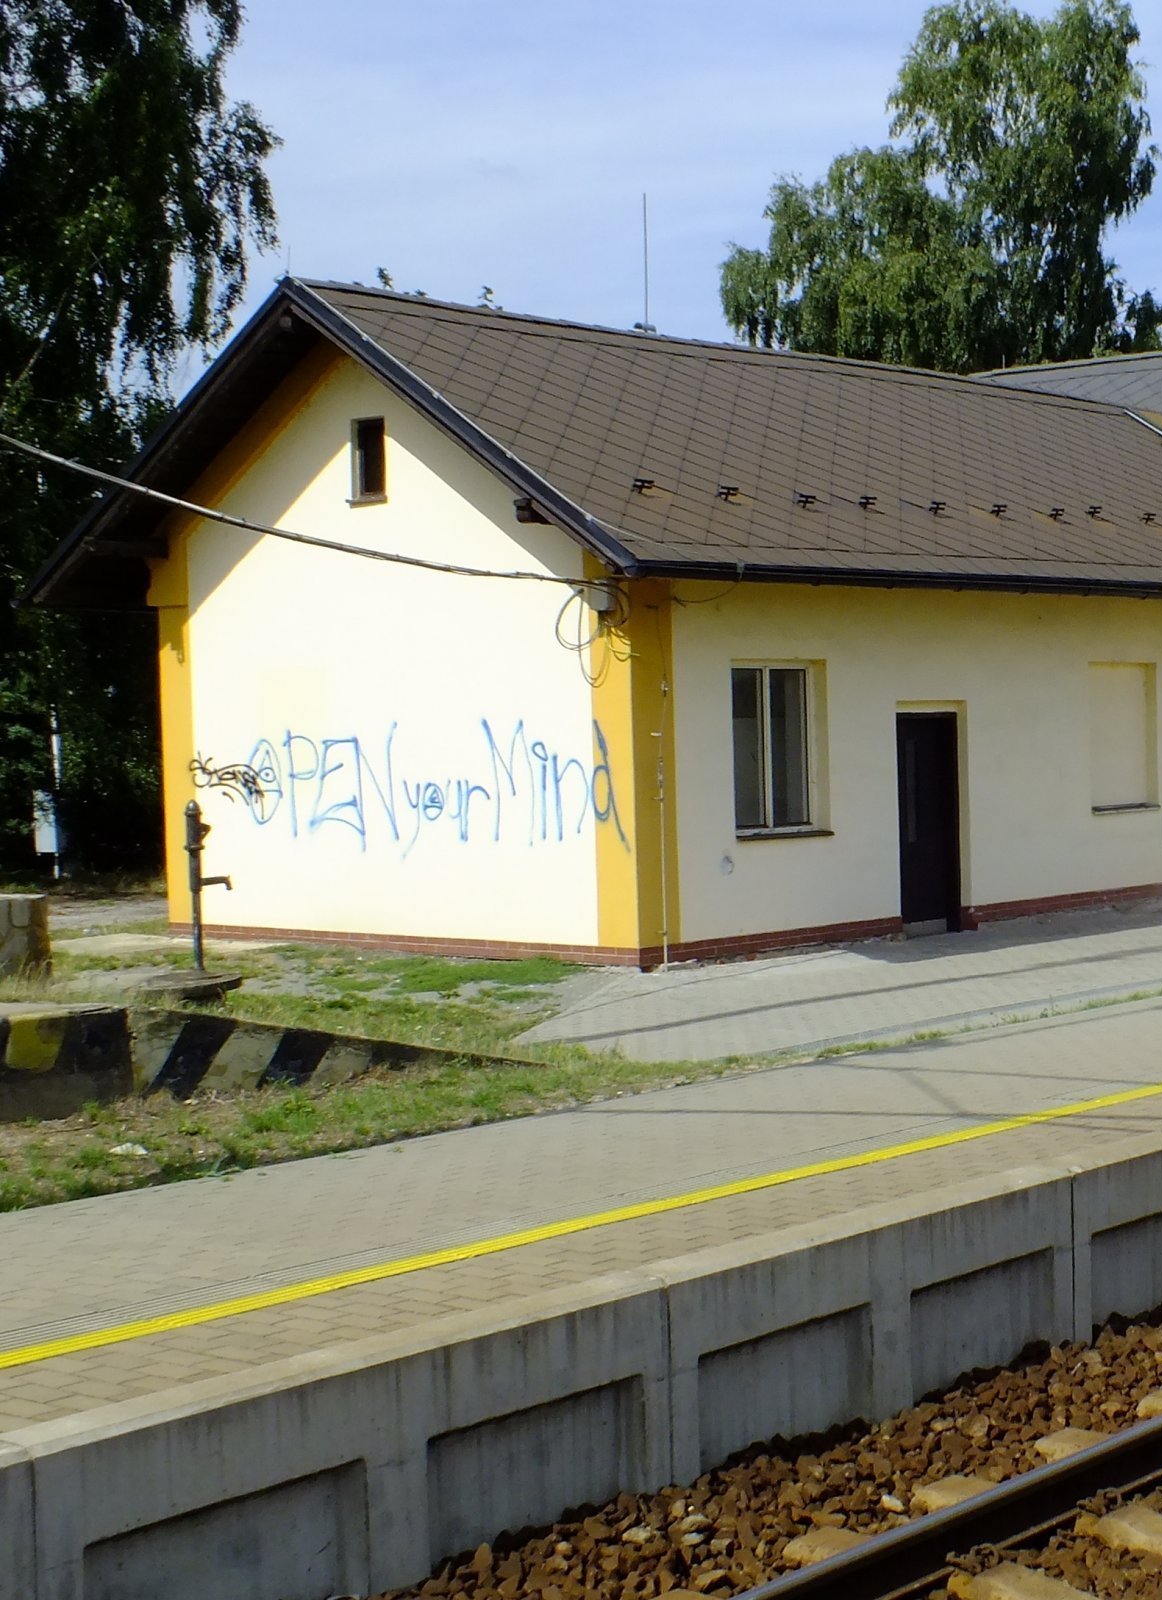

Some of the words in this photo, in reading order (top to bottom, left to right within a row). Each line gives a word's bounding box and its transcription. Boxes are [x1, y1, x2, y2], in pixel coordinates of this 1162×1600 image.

[247, 719, 401, 852] OPEN
[402, 777, 491, 860] your
[480, 717, 632, 854] Mind
